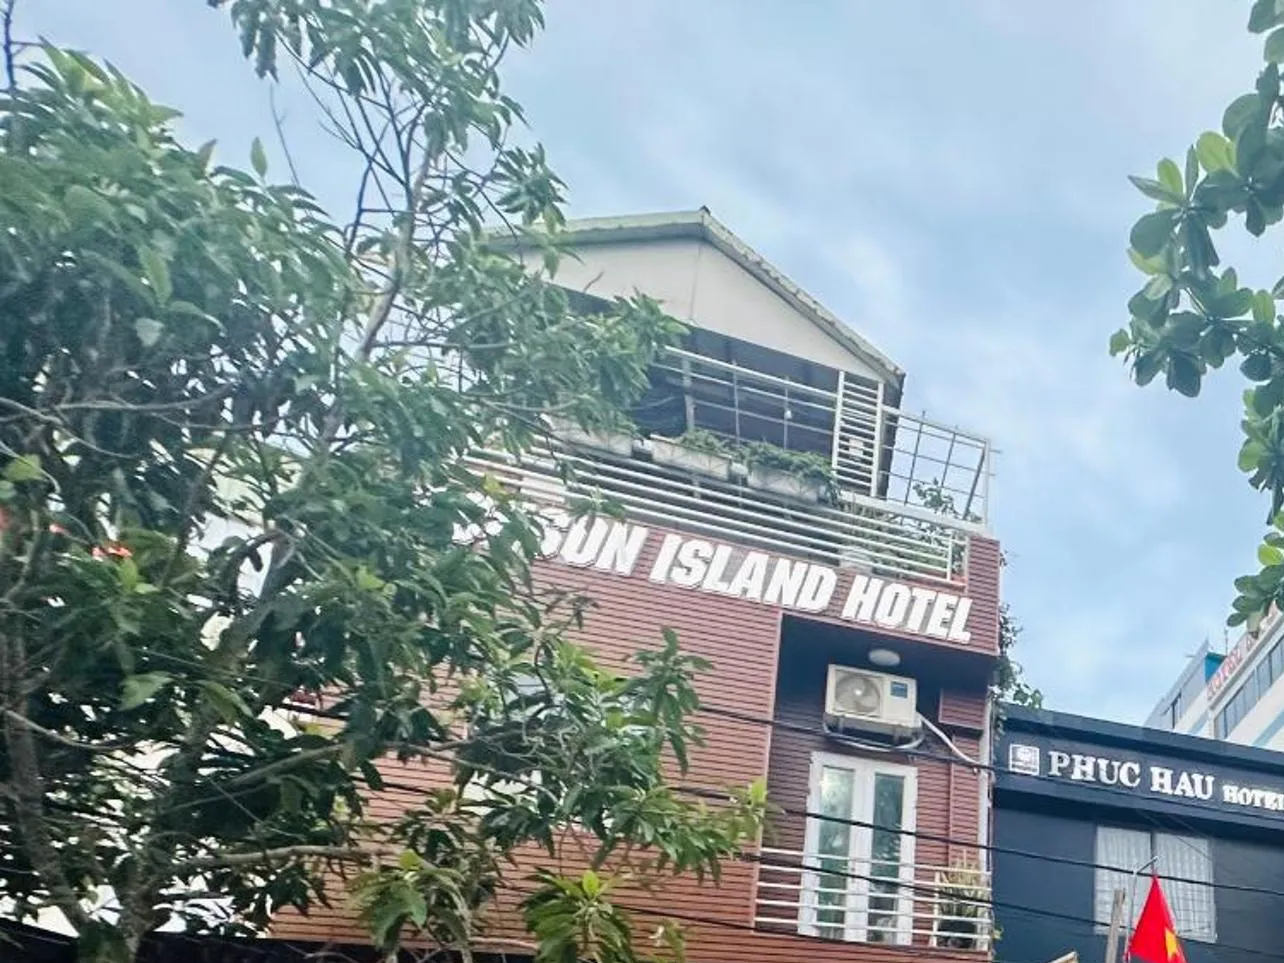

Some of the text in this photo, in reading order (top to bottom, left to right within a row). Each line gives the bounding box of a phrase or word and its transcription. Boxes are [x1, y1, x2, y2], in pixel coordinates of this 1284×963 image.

[534, 512, 974, 645] SUN ISLAND HOTEL
[1049, 750, 1142, 788] PHUC
[1150, 767, 1215, 800] HAU
